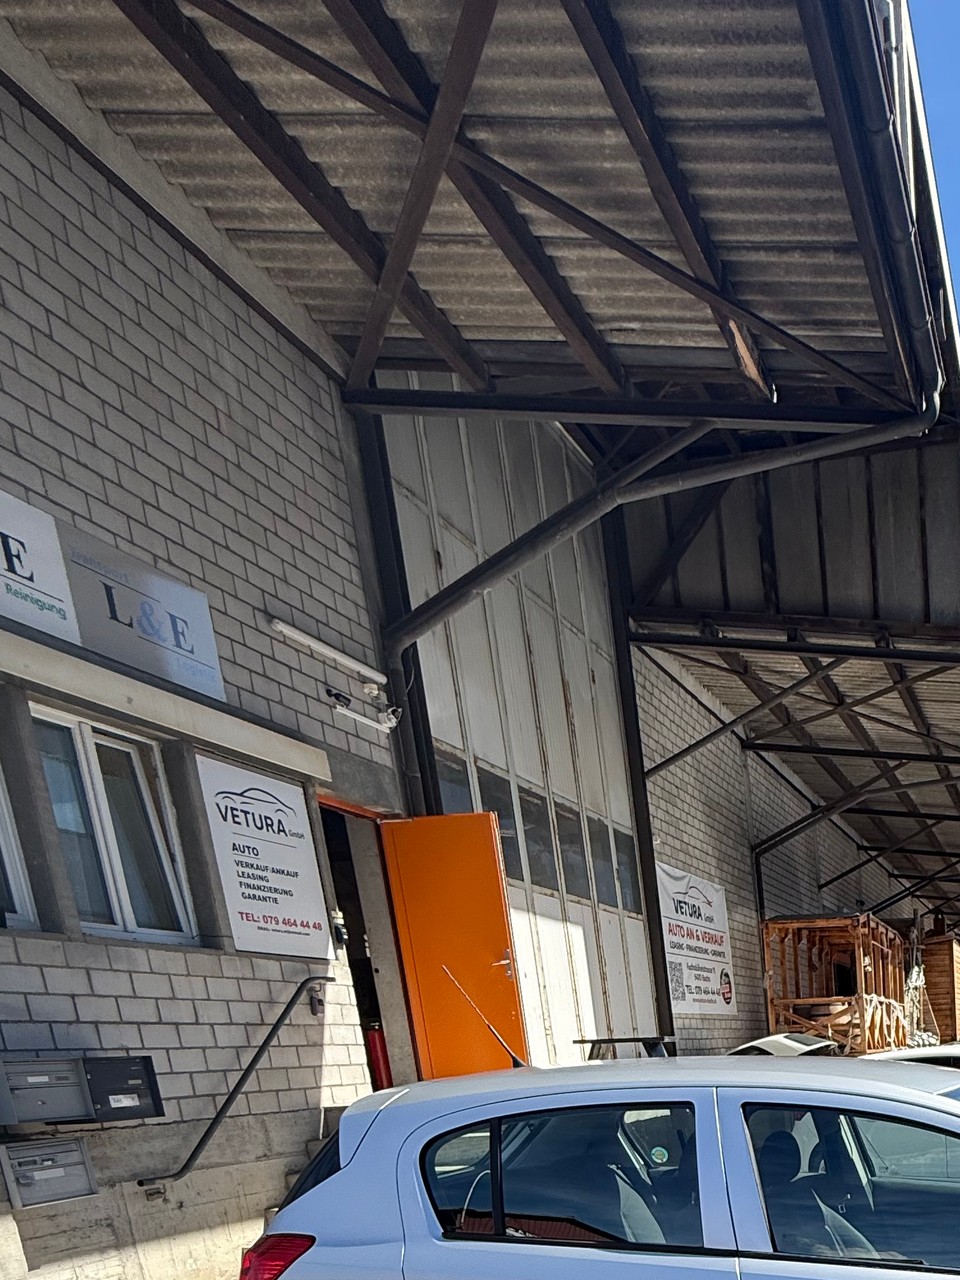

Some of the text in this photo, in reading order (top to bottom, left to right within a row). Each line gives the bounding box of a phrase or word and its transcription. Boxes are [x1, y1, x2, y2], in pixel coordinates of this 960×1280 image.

[4, 582, 67, 620] Reinigung
[215, 802, 305, 840] VETURA GmbH
[232, 842, 259, 856] AUTO
[236, 870, 269, 883] LEASING
[239, 881, 294, 897] FINANZIERUNG
[241, 892, 279, 905] GARANTIE
[672, 897, 703, 921] VETURA
[238, 911, 323, 931] TEL: 079 464 44 48
[668, 921, 686, 939] AUTO
[686, 927, 695, 941] AN
[701, 930, 725, 947] VERKAUF
